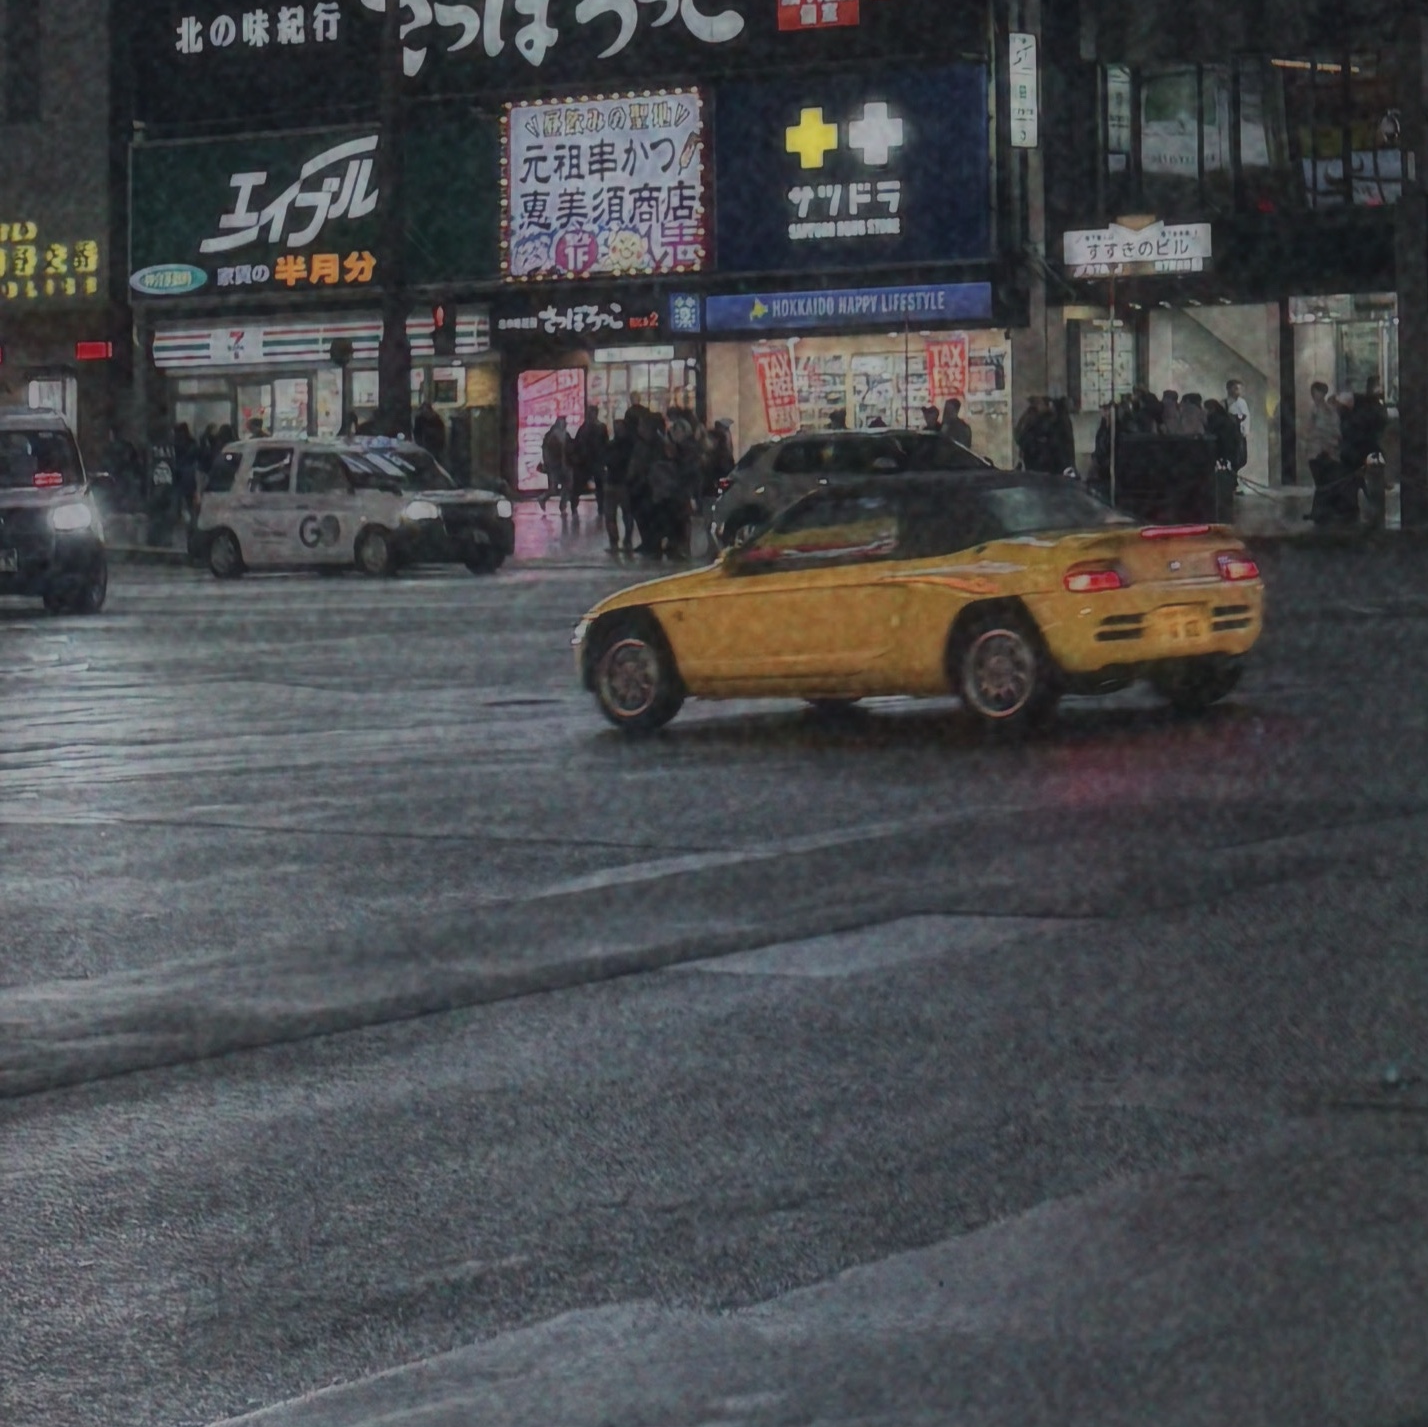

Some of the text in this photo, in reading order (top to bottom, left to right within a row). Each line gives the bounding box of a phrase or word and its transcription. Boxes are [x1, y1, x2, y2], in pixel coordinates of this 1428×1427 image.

[175, 2, 341, 54] 北の味紀行
[519, 137, 676, 185] 元祖串かつ
[199, 135, 379, 254] エイブル
[518, 180, 697, 231] 恵美須商店
[788, 180, 901, 219] サツドラ
[564, 247, 590, 271] 1F
[1086, 239, 1189, 261] すすきのビル
[274, 250, 377, 287] 半月分
[538, 302, 624, 334] さっぽろっこ
[772, 291, 946, 318] HOKKAIDO HAPPY LIFESTYLE
[763, 355, 789, 374] TAX
[930, 345, 961, 367] TAX
[299, 514, 341, 549] GO
